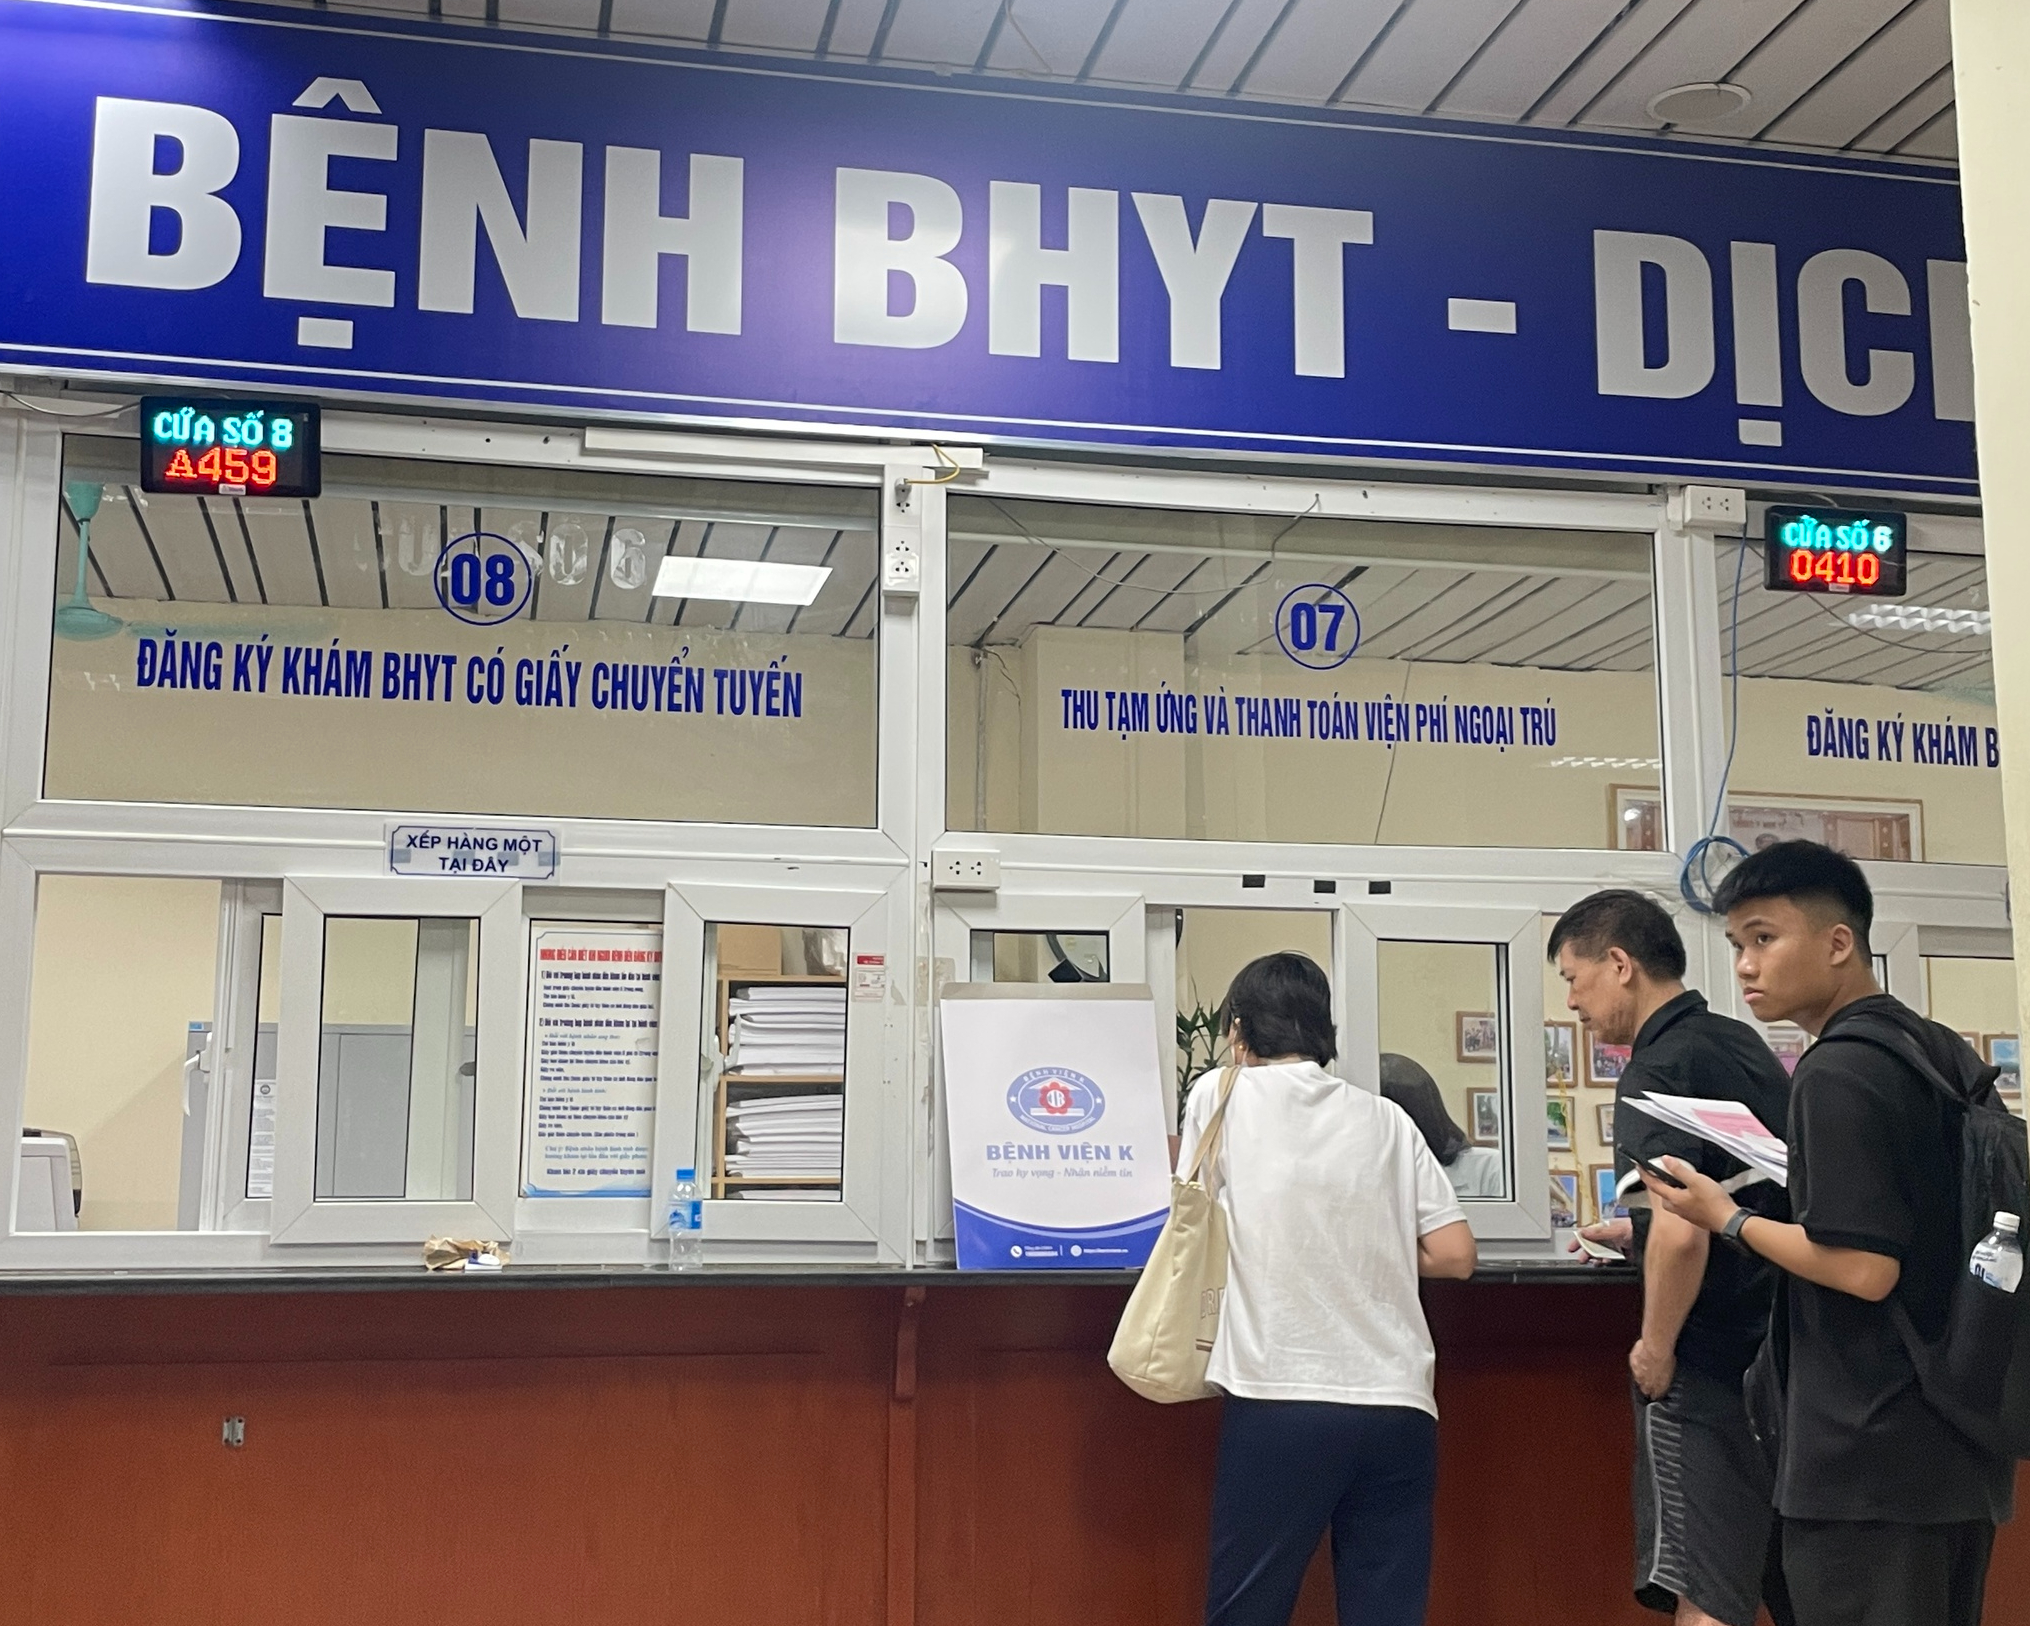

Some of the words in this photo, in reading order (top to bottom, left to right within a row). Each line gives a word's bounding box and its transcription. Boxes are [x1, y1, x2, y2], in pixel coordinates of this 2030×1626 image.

[86, 77, 744, 349] BỆNH
[834, 167, 1373, 378] BHYT
[1448, 297, 1516, 335] -
[222, 410, 264, 445] SỐ
[271, 418, 294, 449] 8
[165, 447, 278, 485] A459
[1835, 519, 1870, 551] SỐ
[1873, 525, 1893, 552] 6
[451, 553, 515, 606] 08
[1290, 602, 1345, 652] 07
[137, 628, 223, 690] ĐĂNG
[233, 634, 273, 692] KÝ
[282, 638, 372, 698] KHÁM
[382, 651, 457, 702] BHYT
[466, 646, 505, 705] CÓ
[515, 644, 582, 707] GIẤY
[591, 646, 705, 713] CHUYỂN
[713, 655, 802, 718] TUYẾN
[1061, 689, 1099, 730] THU
[1105, 691, 1149, 740] TẠM
[1156, 681, 1197, 734] ỨNG
[1203, 686, 1230, 735] VÀ
[1235, 697, 1301, 738] THANH
[1307, 692, 1359, 740] TOÁN
[1364, 693, 1410, 749] VIỆN
[1415, 695, 1448, 743] PHÍ
[1454, 705, 1514, 752] NGOẠI
[1519, 697, 1556, 746] TRÚ
[1807, 707, 1870, 760] ĐĂNG
[1876, 712, 1905, 763] KÝ
[1912, 715, 1978, 767] KHÁM
[406, 830, 441, 849] XẾP
[447, 832, 498, 851] HÀNG
[503, 835, 542, 855] MỘT
[439, 857, 467, 873] TẠI
[472, 857, 509, 872] ĐÂY
[986, 1141, 1050, 1164] BỆNH
[1057, 1141, 1111, 1164] VIỆN
[1119, 1144, 1134, 1160] K
